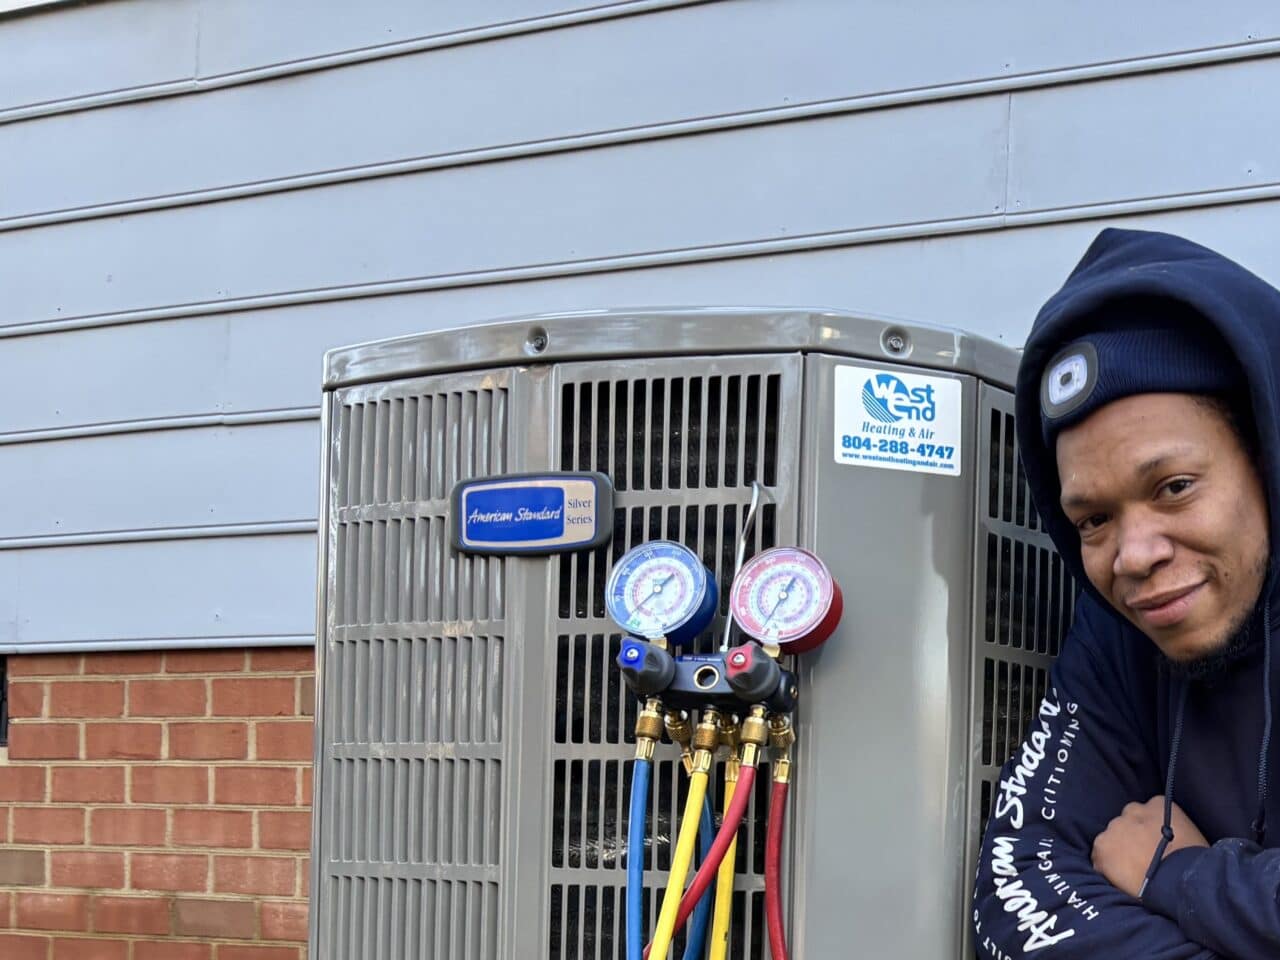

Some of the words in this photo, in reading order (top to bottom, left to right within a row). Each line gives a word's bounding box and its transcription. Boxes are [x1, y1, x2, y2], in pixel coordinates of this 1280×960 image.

[862, 421, 905, 438] Heating
[908, 427, 916, 437] &
[918, 428, 935, 440] Air
[842, 435, 954, 459] 804-288-4747
[567, 499, 592, 509] Silver
[468, 508, 512, 524] American
[514, 505, 562, 522] Standard
[567, 514, 593, 524] Series
